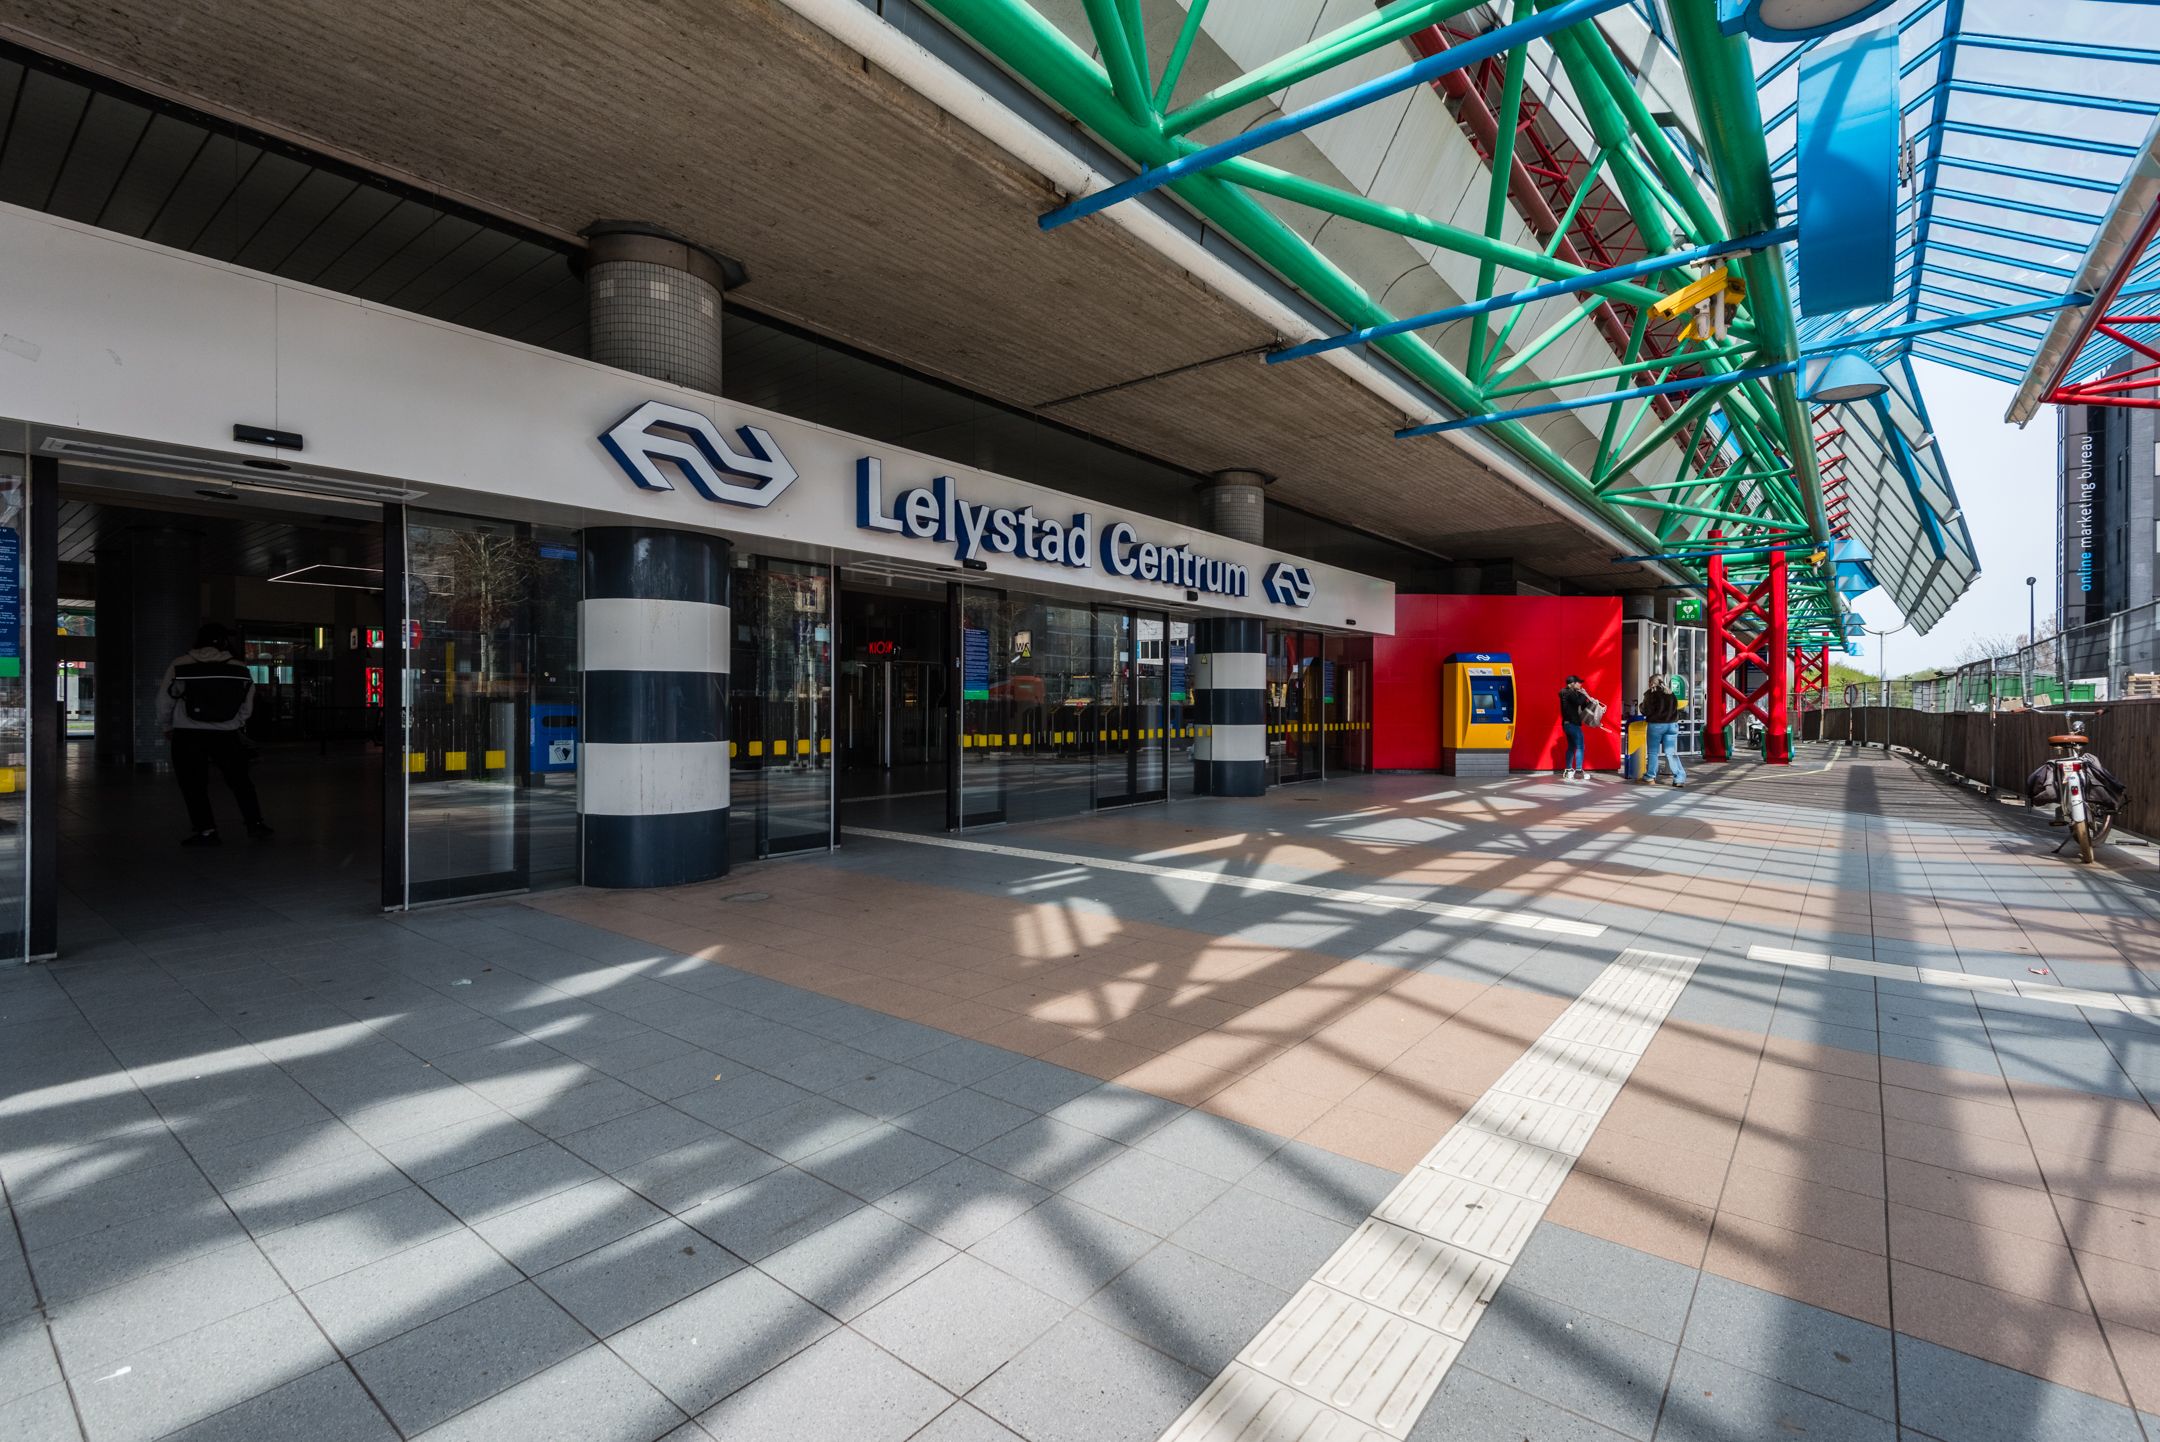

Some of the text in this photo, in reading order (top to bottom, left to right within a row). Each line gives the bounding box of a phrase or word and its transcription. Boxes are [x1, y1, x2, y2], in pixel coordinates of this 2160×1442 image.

[856, 456, 1249, 598] Lelystad Centrum
[2076, 436, 2096, 592] online marketing bureau
